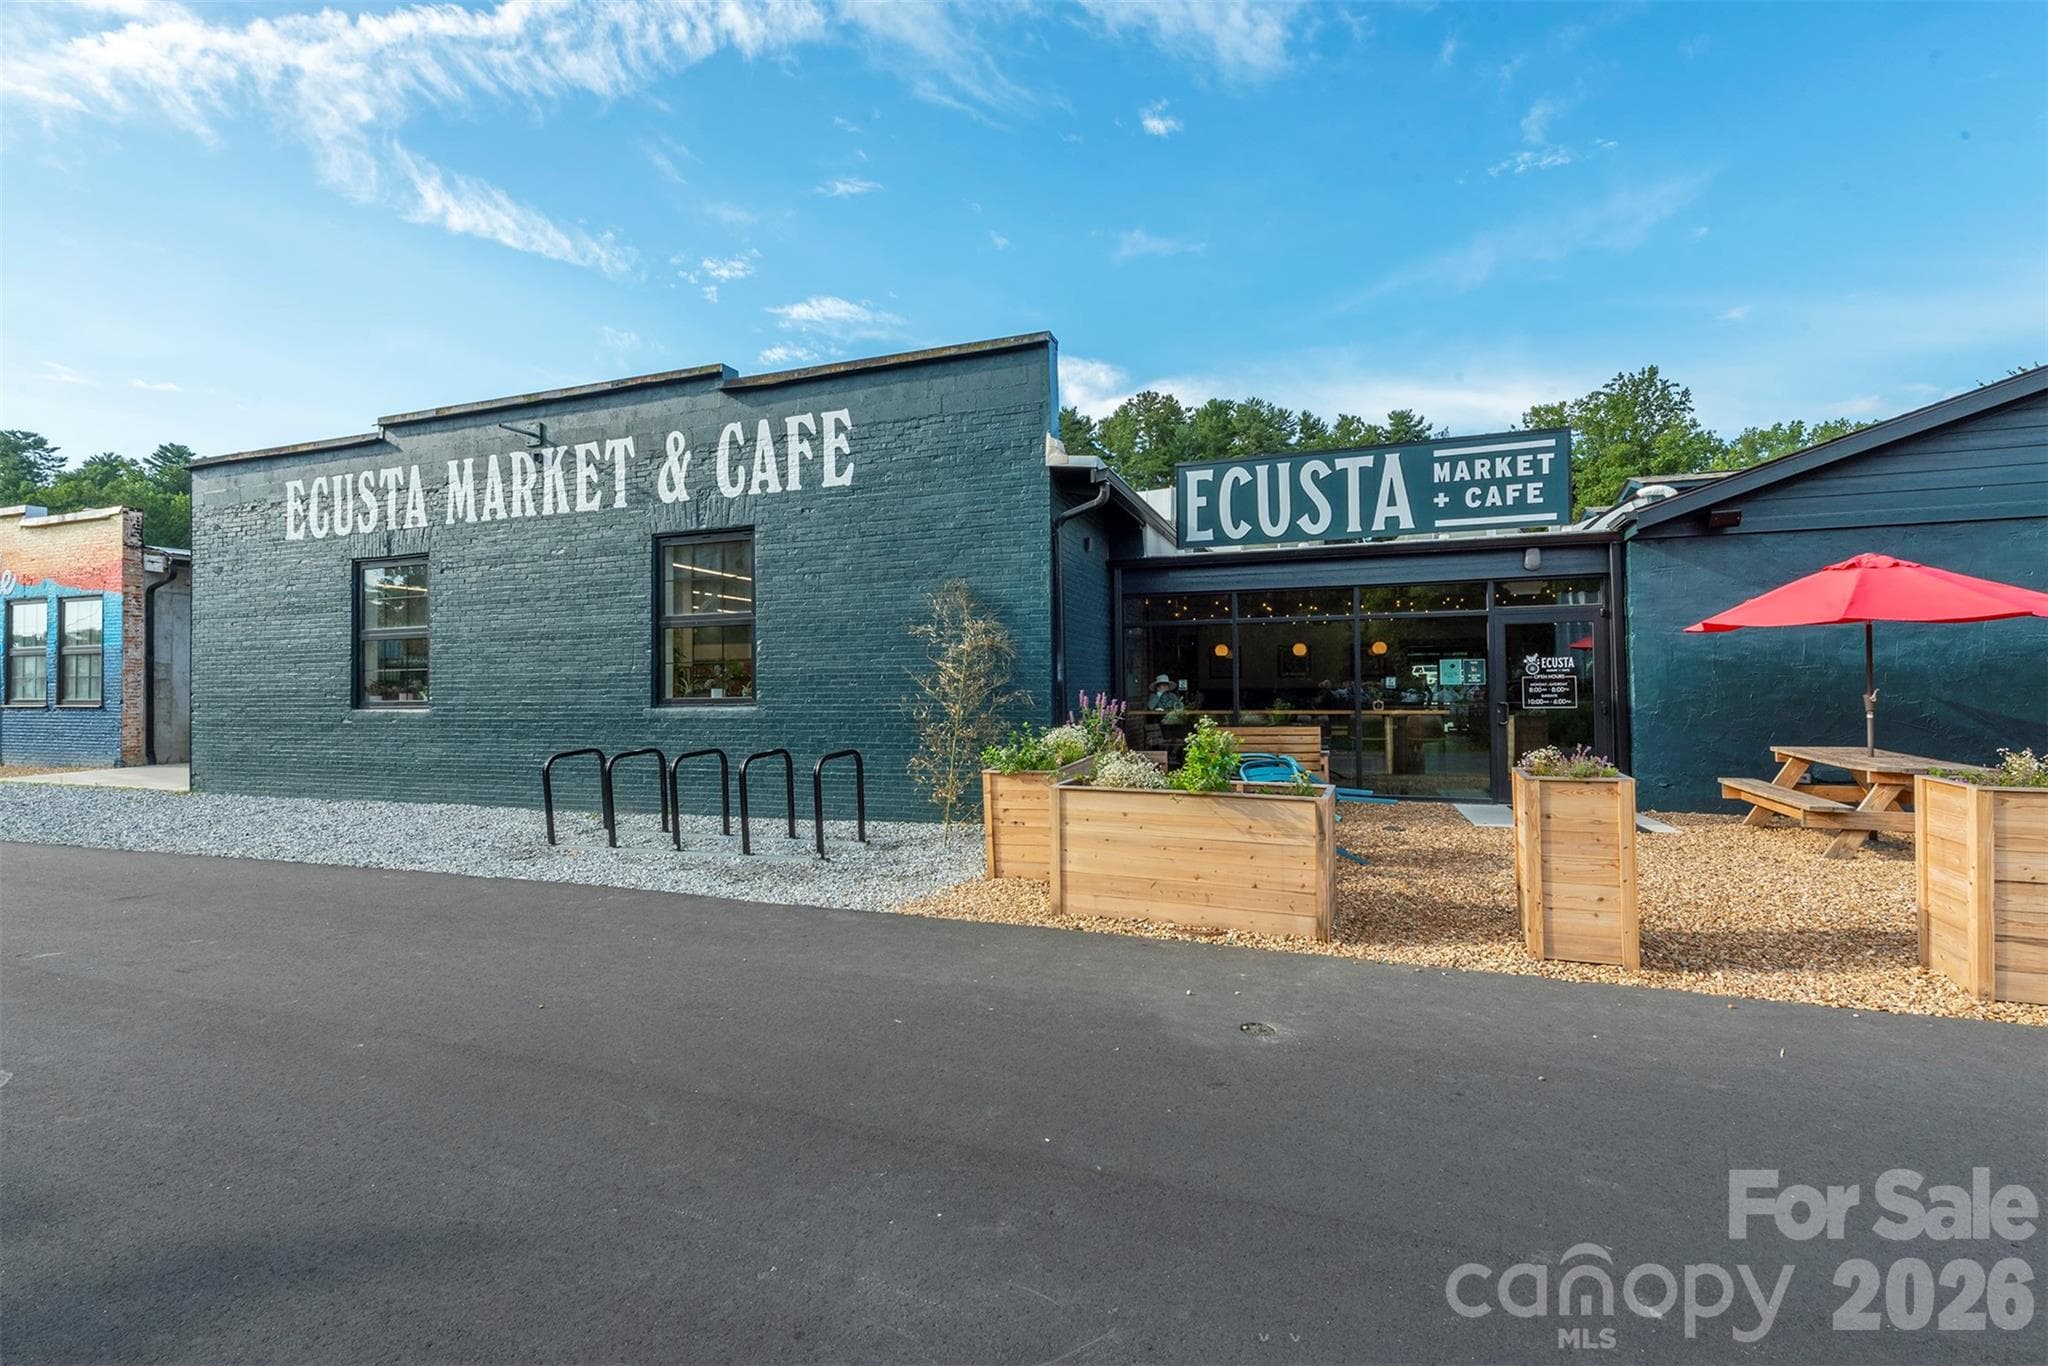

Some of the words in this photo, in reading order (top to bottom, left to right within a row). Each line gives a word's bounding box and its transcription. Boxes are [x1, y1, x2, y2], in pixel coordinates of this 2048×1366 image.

[285, 465, 429, 541] ECUSTA
[445, 436, 635, 525] MARKET
[658, 431, 691, 504] &
[715, 408, 855, 498] CAFE
[1433, 453, 1555, 483] MARKET
[1186, 453, 1415, 542] ECUSTA
[1433, 493, 1450, 508] +
[1465, 482, 1544, 508] CAFE
[1541, 657, 1575, 668] ECUSTA
